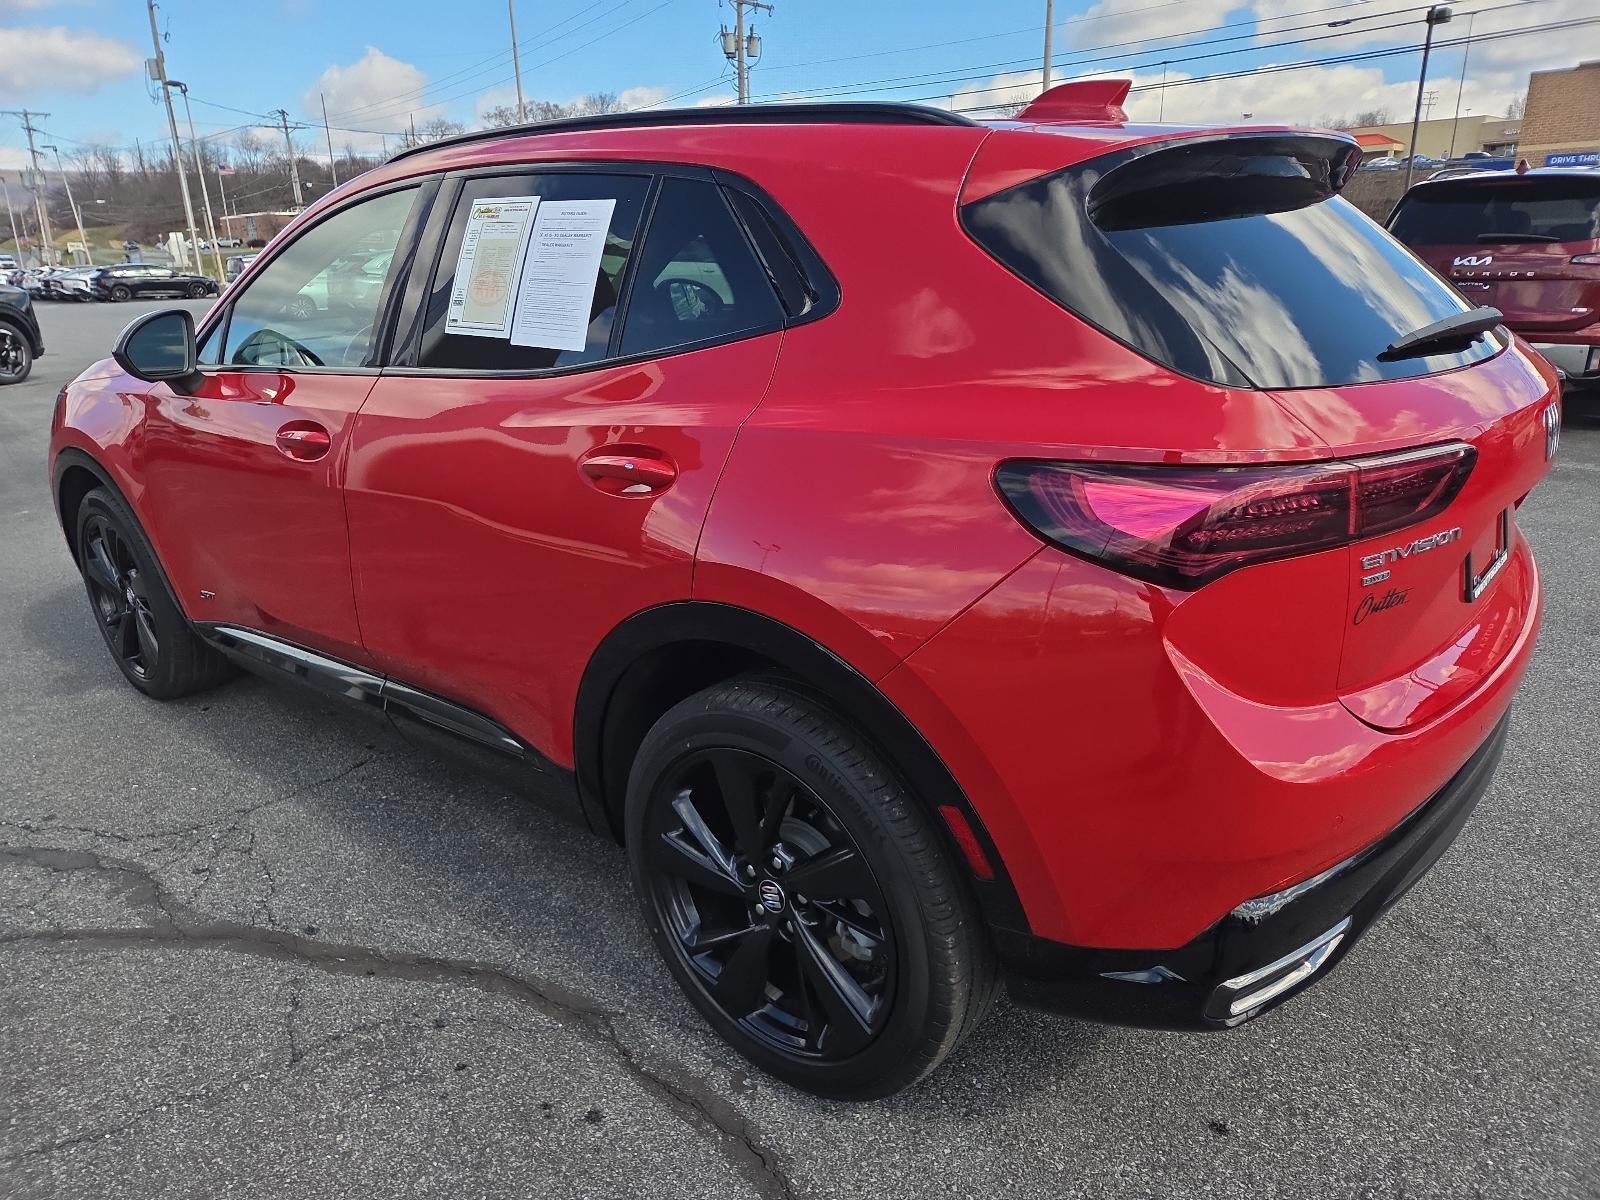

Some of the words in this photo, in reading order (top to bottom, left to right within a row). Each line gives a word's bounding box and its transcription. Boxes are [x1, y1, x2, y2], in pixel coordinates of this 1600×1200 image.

[1551, 155, 1577, 164] DRIVE
[1454, 256, 1493, 266] KIA
[1354, 586, 1414, 625] Outten
